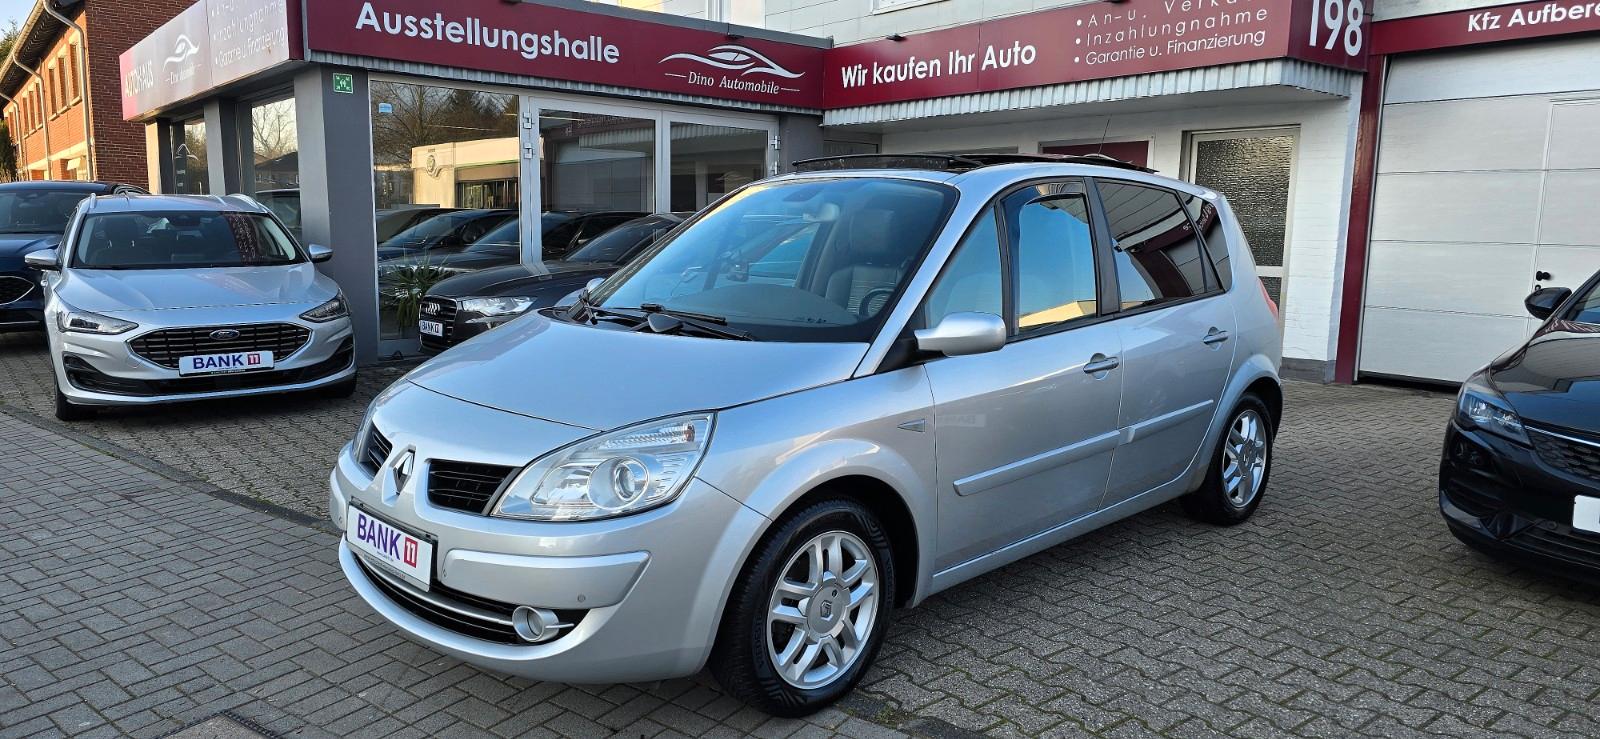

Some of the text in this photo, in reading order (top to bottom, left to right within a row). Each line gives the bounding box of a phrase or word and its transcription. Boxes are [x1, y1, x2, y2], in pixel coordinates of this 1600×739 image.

[355, 1, 620, 64] Ausstellungshalle
[1086, 8, 1268, 47] Inzahlungnahme
[1309, 0, 1364, 57] 198
[1467, 11, 1502, 32] Kfz
[841, 40, 1037, 88] Wir kaufen Ihr Auto
[1085, 29, 1266, 65] Garantie u. Finanzierung
[688, 71, 780, 95] Dino Automobile
[193, 354, 244, 370] BANK
[357, 513, 415, 564] BANK 11
